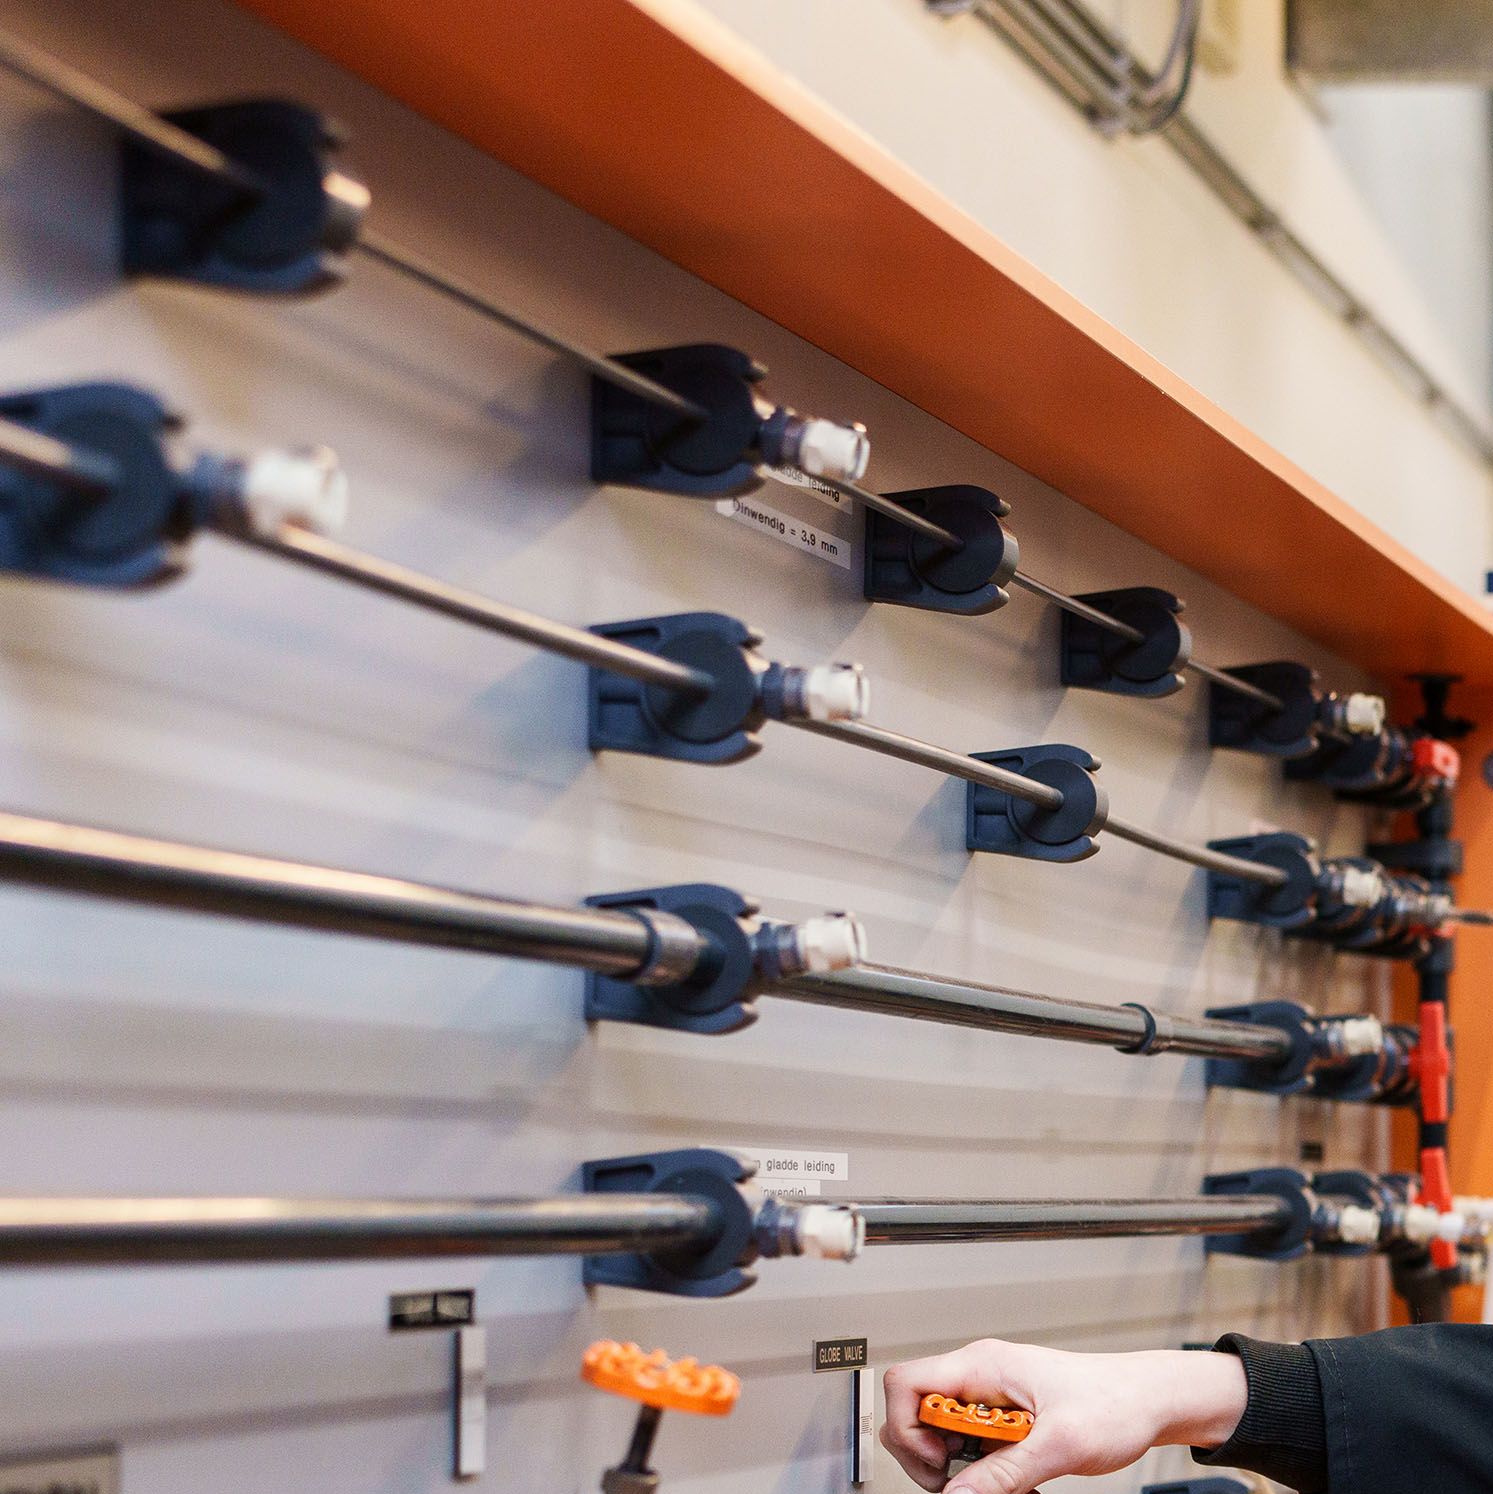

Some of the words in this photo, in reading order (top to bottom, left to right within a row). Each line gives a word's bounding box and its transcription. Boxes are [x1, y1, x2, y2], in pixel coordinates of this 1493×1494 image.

[801, 530, 816, 546] 3,9
[821, 541, 838, 556] mm
[766, 1158, 799, 1171] gladde
[803, 1160, 835, 1174] leiding
[820, 1347, 841, 1363] GLOBE
[844, 1345, 863, 1361] VALVE
